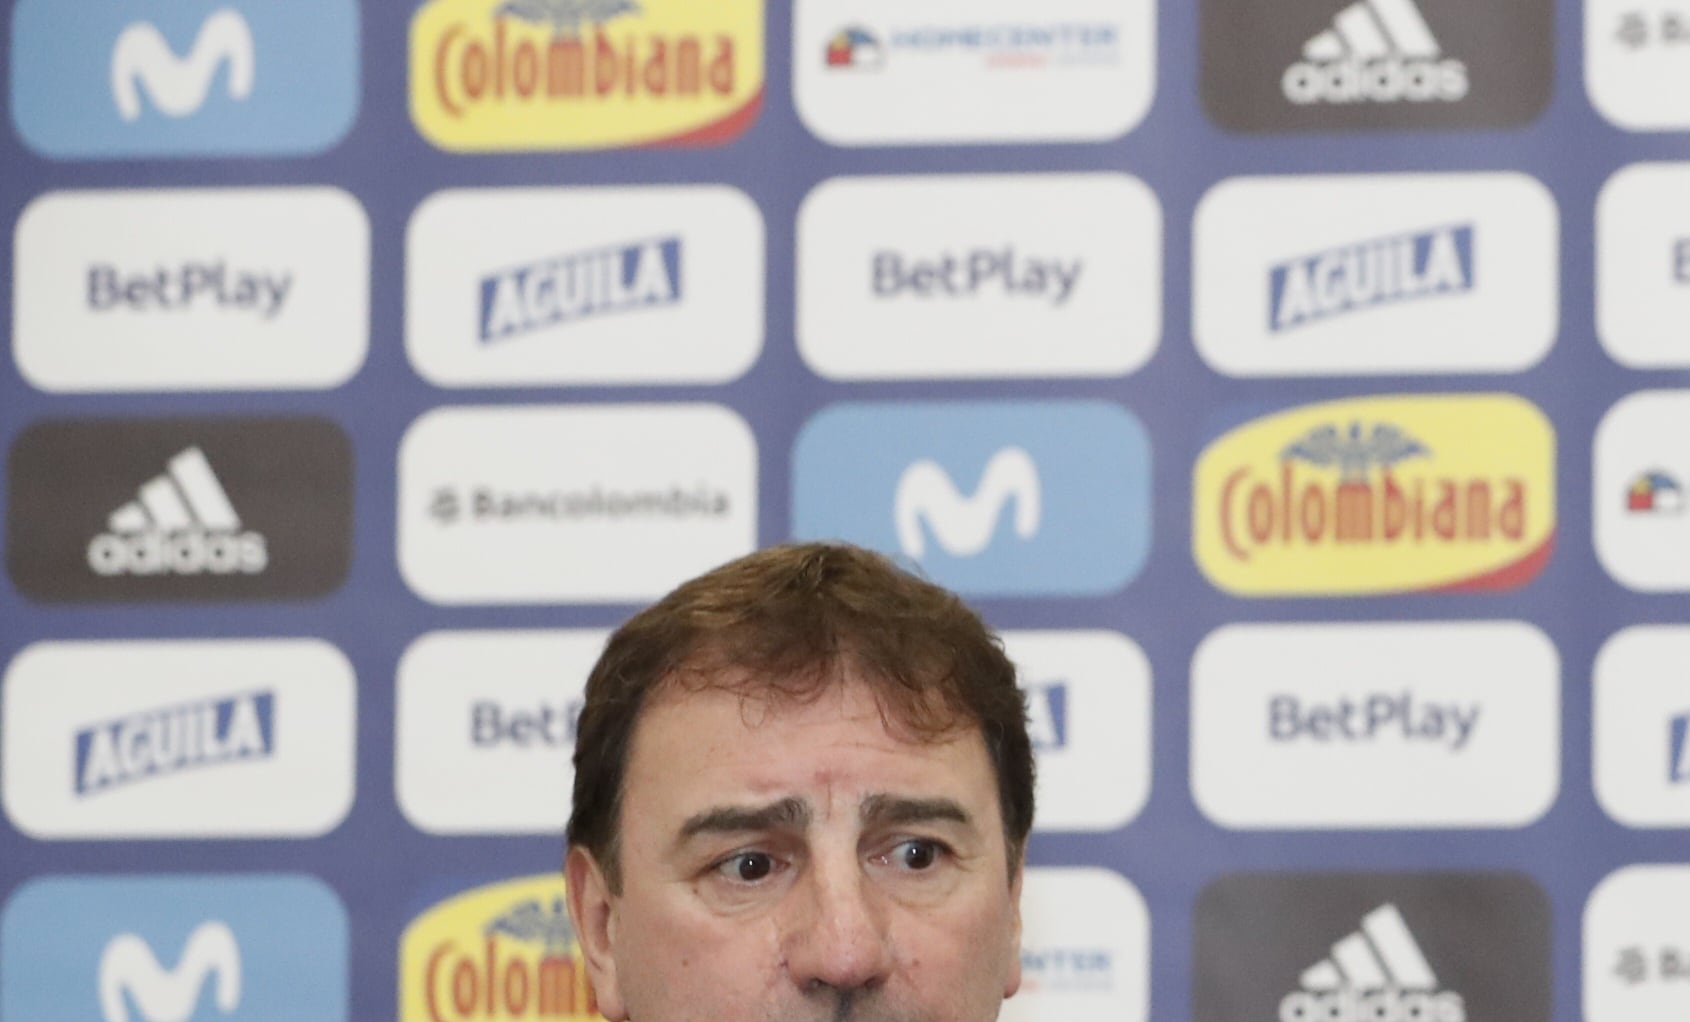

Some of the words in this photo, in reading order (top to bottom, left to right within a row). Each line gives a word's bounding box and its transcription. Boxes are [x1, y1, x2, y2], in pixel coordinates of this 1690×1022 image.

[435, 17, 736, 118] Colombiana
[1281, 54, 1468, 103] adidas
[86, 258, 291, 321] BetPlay
[484, 238, 676, 342] AGUILA
[871, 244, 1082, 307] BetPlay
[1274, 227, 1468, 332] AGUILA
[471, 485, 729, 522] Bancolombia
[1219, 463, 1526, 562] Colombiana
[88, 529, 267, 575] adidas
[78, 692, 270, 795] AGUILA
[1268, 692, 1479, 752] BetPlay
